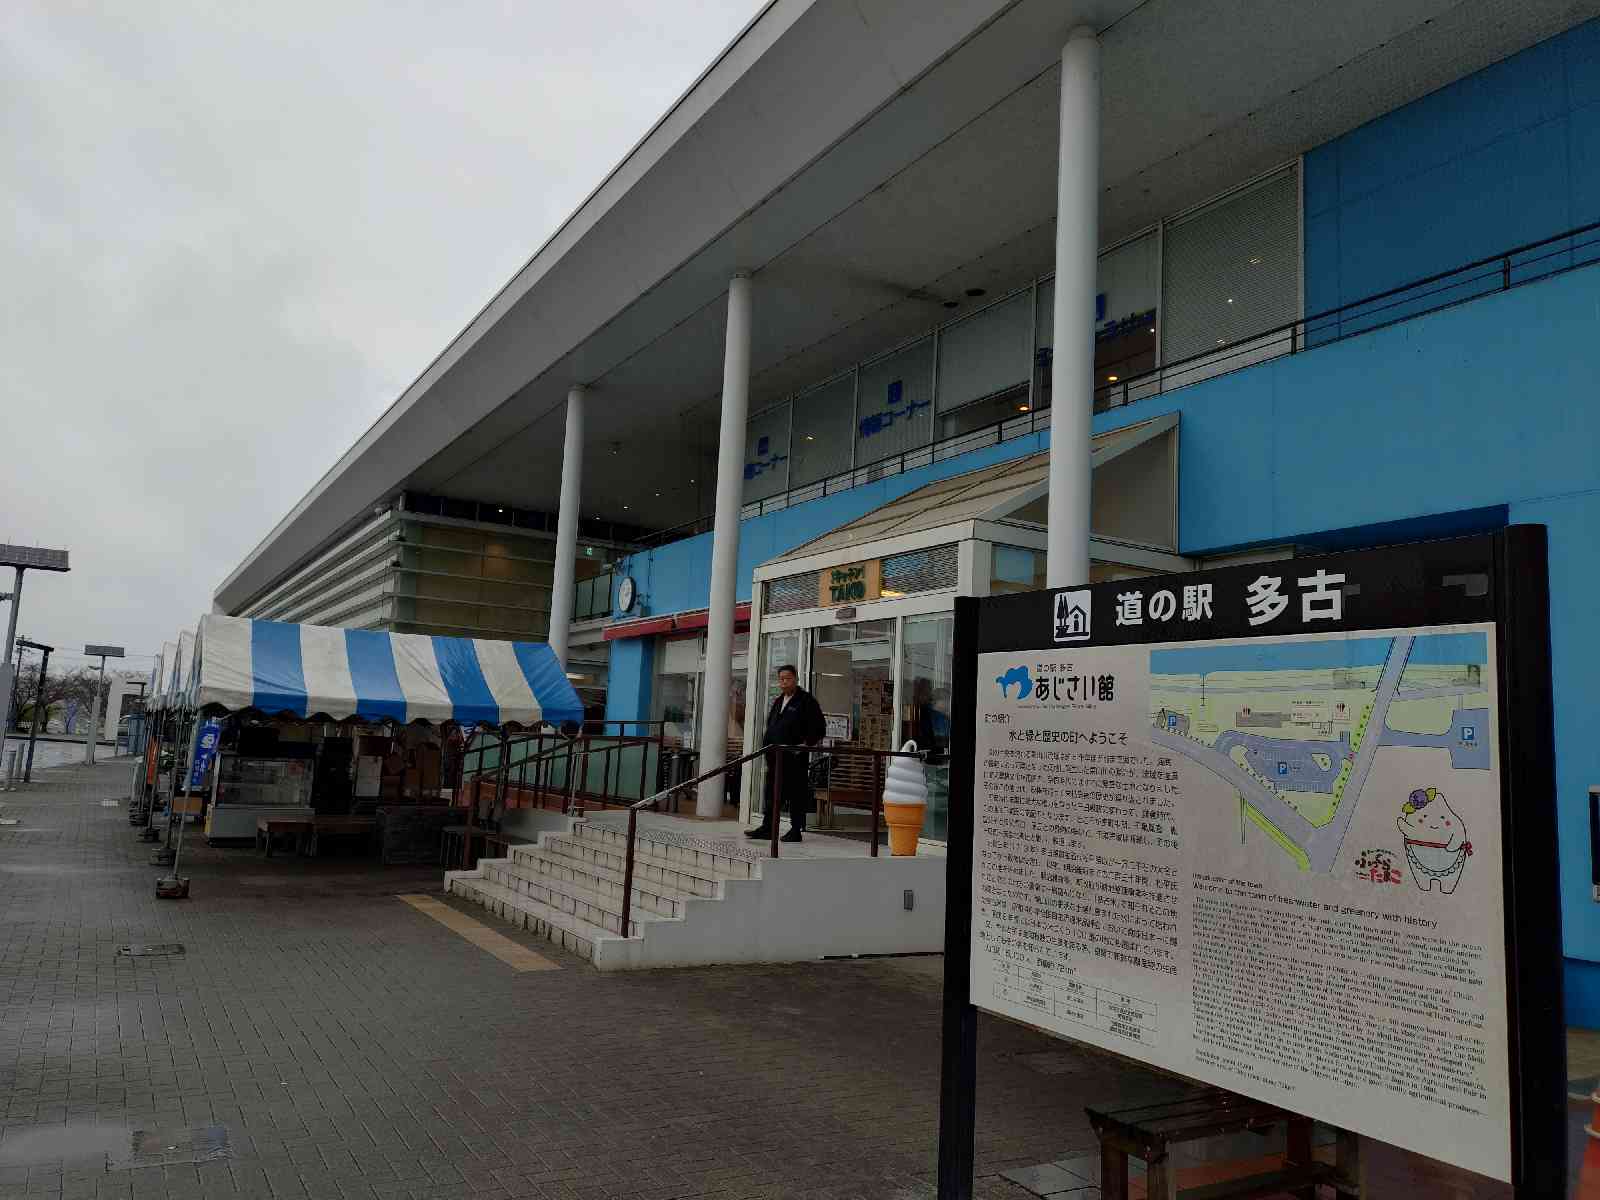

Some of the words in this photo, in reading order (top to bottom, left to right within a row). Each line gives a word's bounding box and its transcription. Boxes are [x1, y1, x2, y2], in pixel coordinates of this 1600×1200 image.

[1115, 583, 1213, 626] 道の駅
[1246, 569, 1346, 626] 多古
[1035, 675, 1115, 702] あじさい館
[1404, 914, 1438, 929] history
